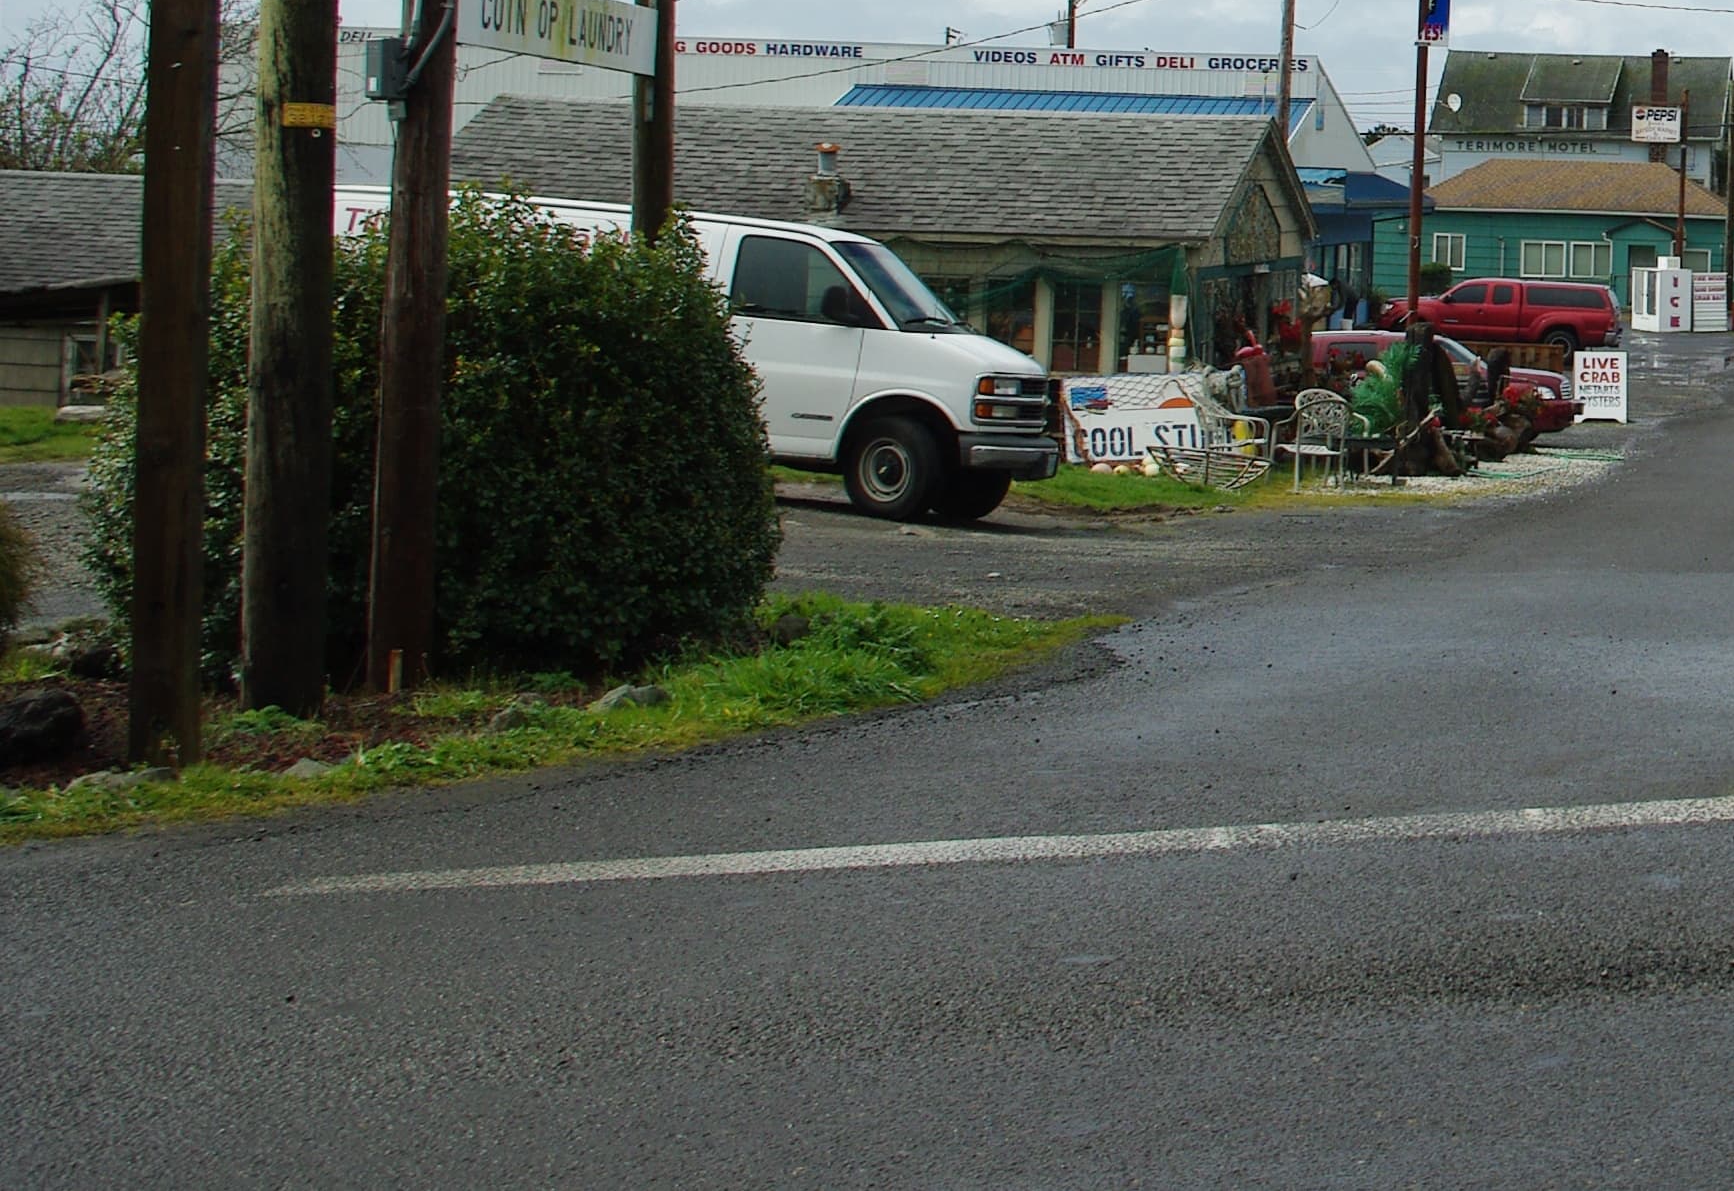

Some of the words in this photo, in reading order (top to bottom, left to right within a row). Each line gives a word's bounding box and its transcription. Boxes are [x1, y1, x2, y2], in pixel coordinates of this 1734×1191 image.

[568, 5, 634, 56] LAUNDRY
[1420, 23, 1444, 41] ES!
[696, 41, 757, 55] GOODS
[766, 43, 864, 58] HARDWARE
[974, 50, 1038, 64] VIDEOS
[1050, 53, 1086, 67] ATM
[1096, 54, 1146, 68] GIFTS
[1157, 56, 1195, 69] DELI
[1208, 57, 1309, 71] GROCERES
[1646, 109, 1678, 123] PEPSI
[1455, 141, 1536, 153] TERIMORE
[1670, 274, 1681, 328] ICE
[1583, 357, 1619, 369] LIVE
[1580, 371, 1621, 383] CRAB
[1579, 385, 1621, 395] NETARTS
[1074, 426, 1143, 458] COOL
